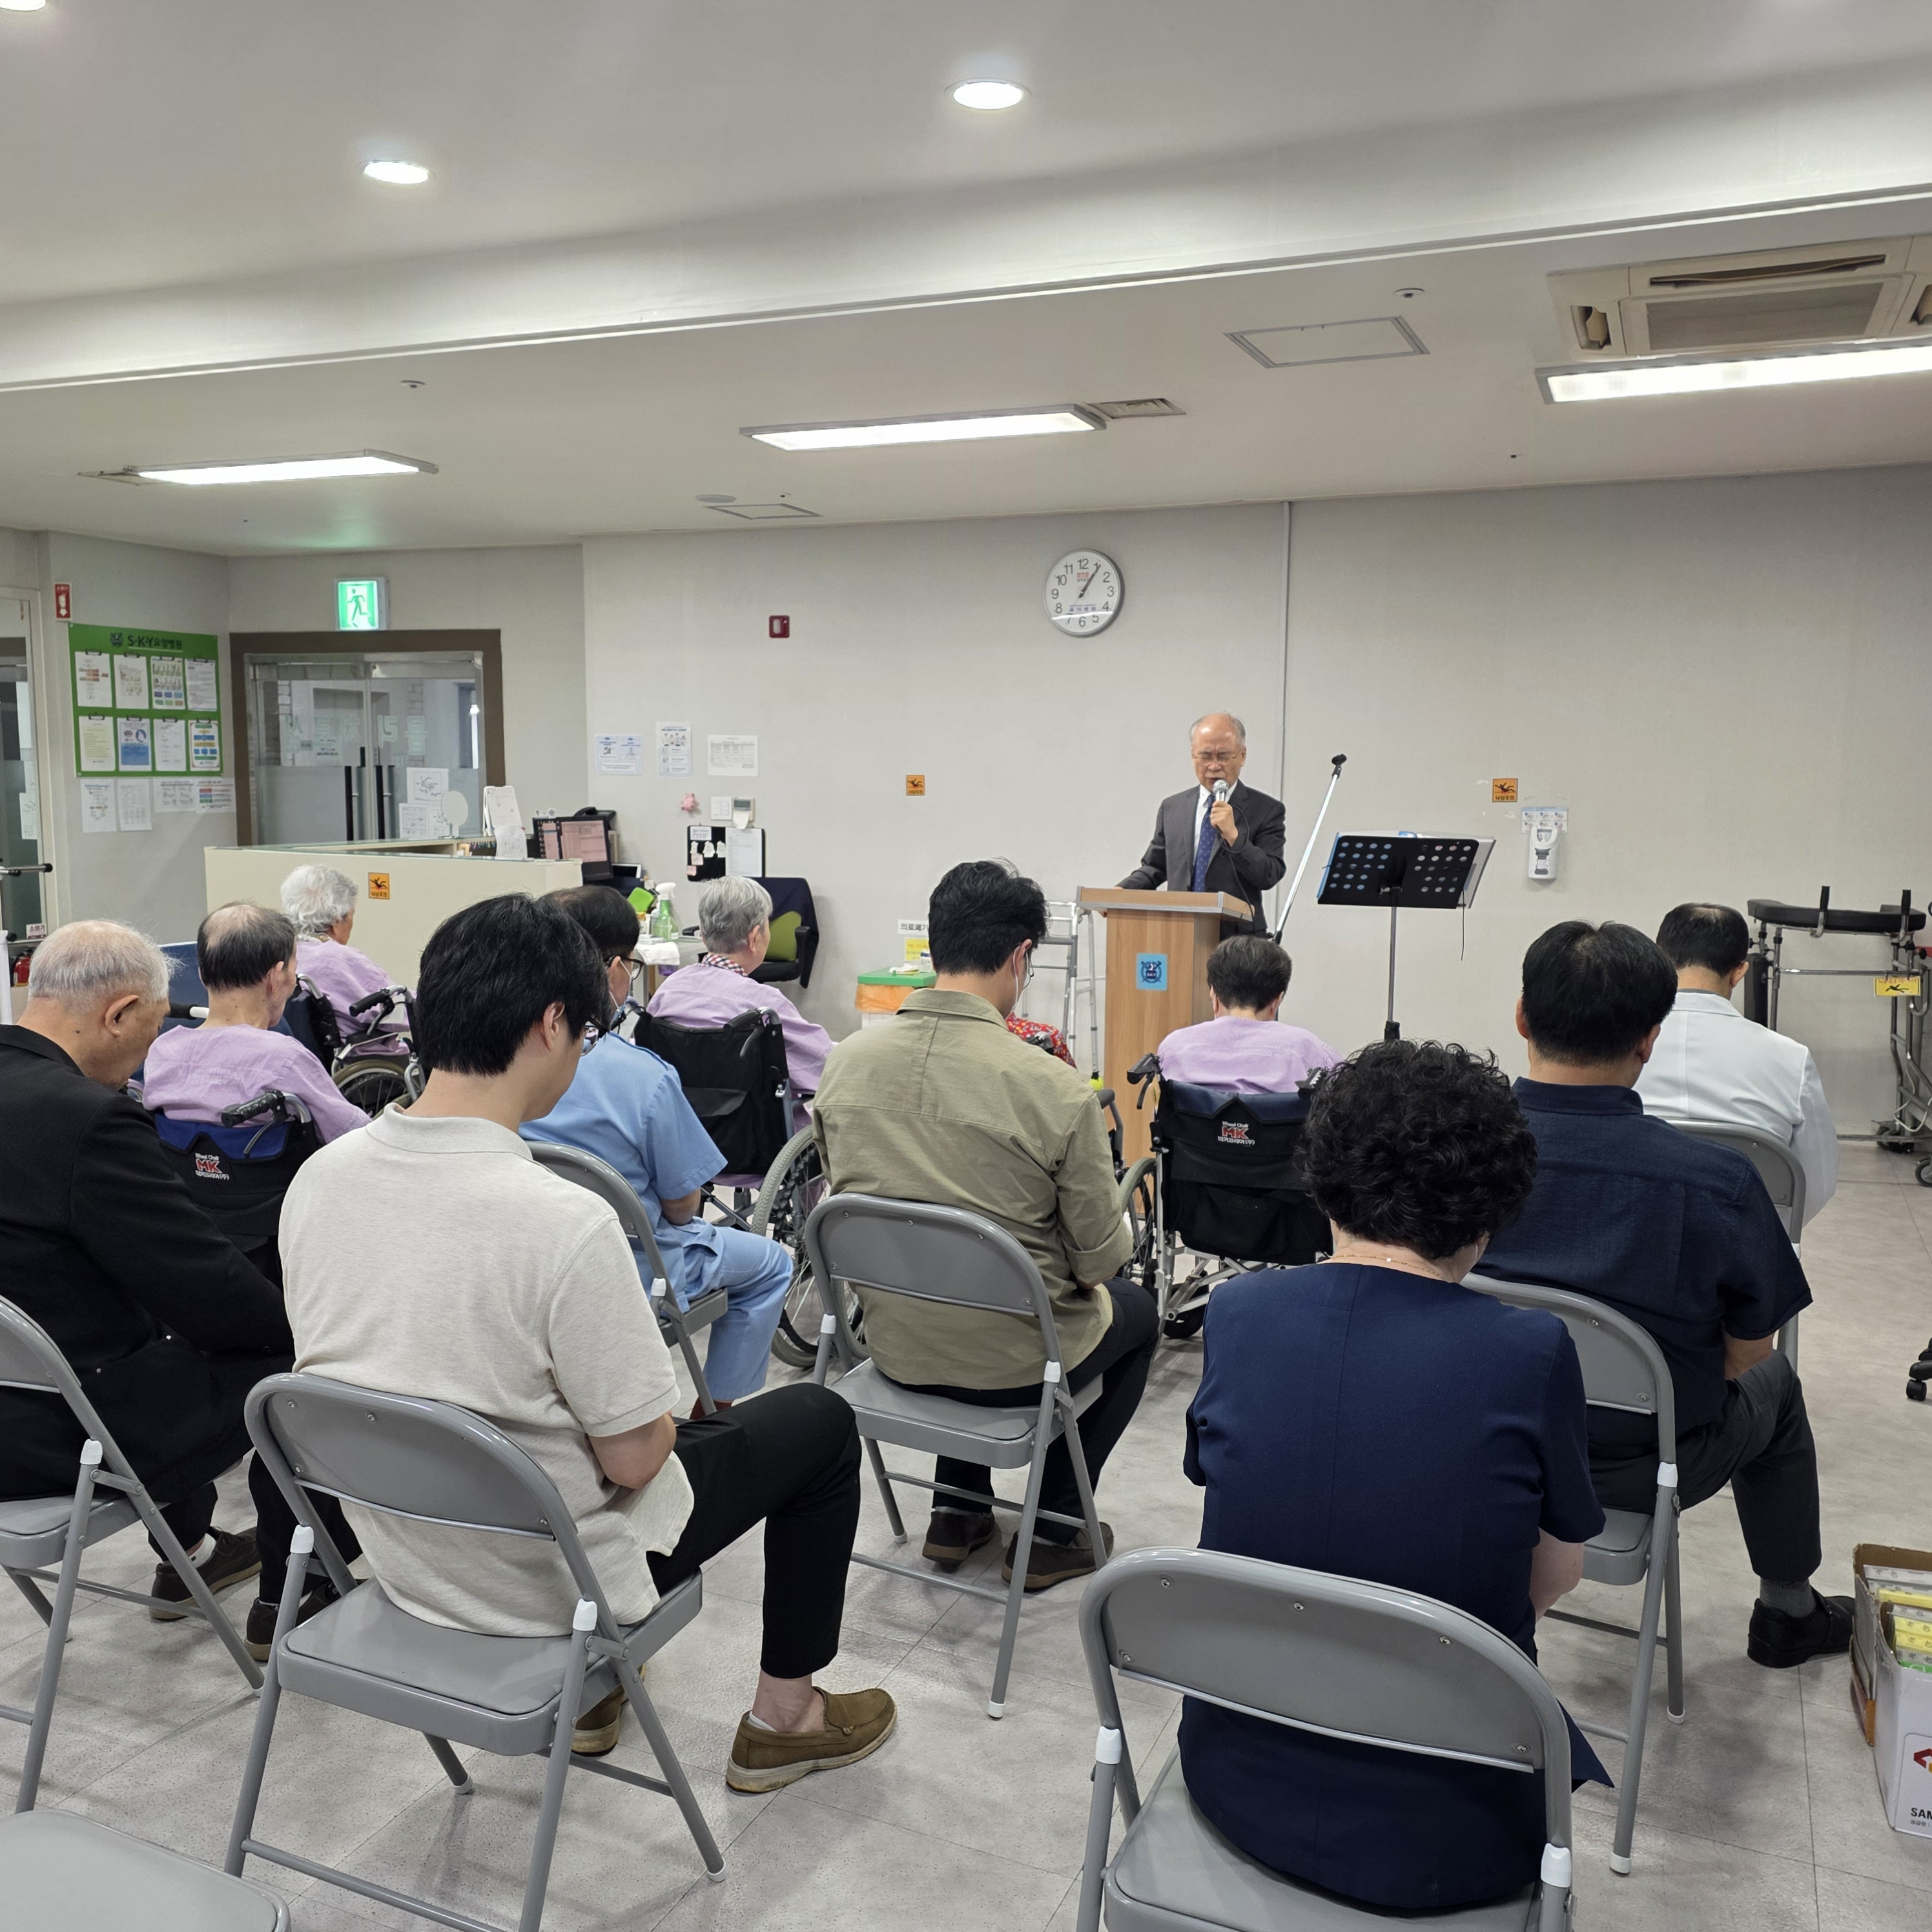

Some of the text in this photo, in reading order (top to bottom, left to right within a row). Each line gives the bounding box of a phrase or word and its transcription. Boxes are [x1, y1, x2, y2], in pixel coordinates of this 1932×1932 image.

[1064, 564, 1073, 574] 11
[1077, 558, 1089, 570] 12
[1056, 575, 1067, 586] 10
[1103, 571, 1110, 582] 2
[1051, 588, 1059, 599] 9
[1107, 586, 1115, 597] 3
[1055, 602, 1062, 613] 8
[1102, 601, 1109, 611] 4
[1079, 616, 1086, 627] 6
[900, 923, 929, 931] 의료폐기
[1222, 1125, 1249, 1140] MK
[196, 1158, 223, 1173] MK
